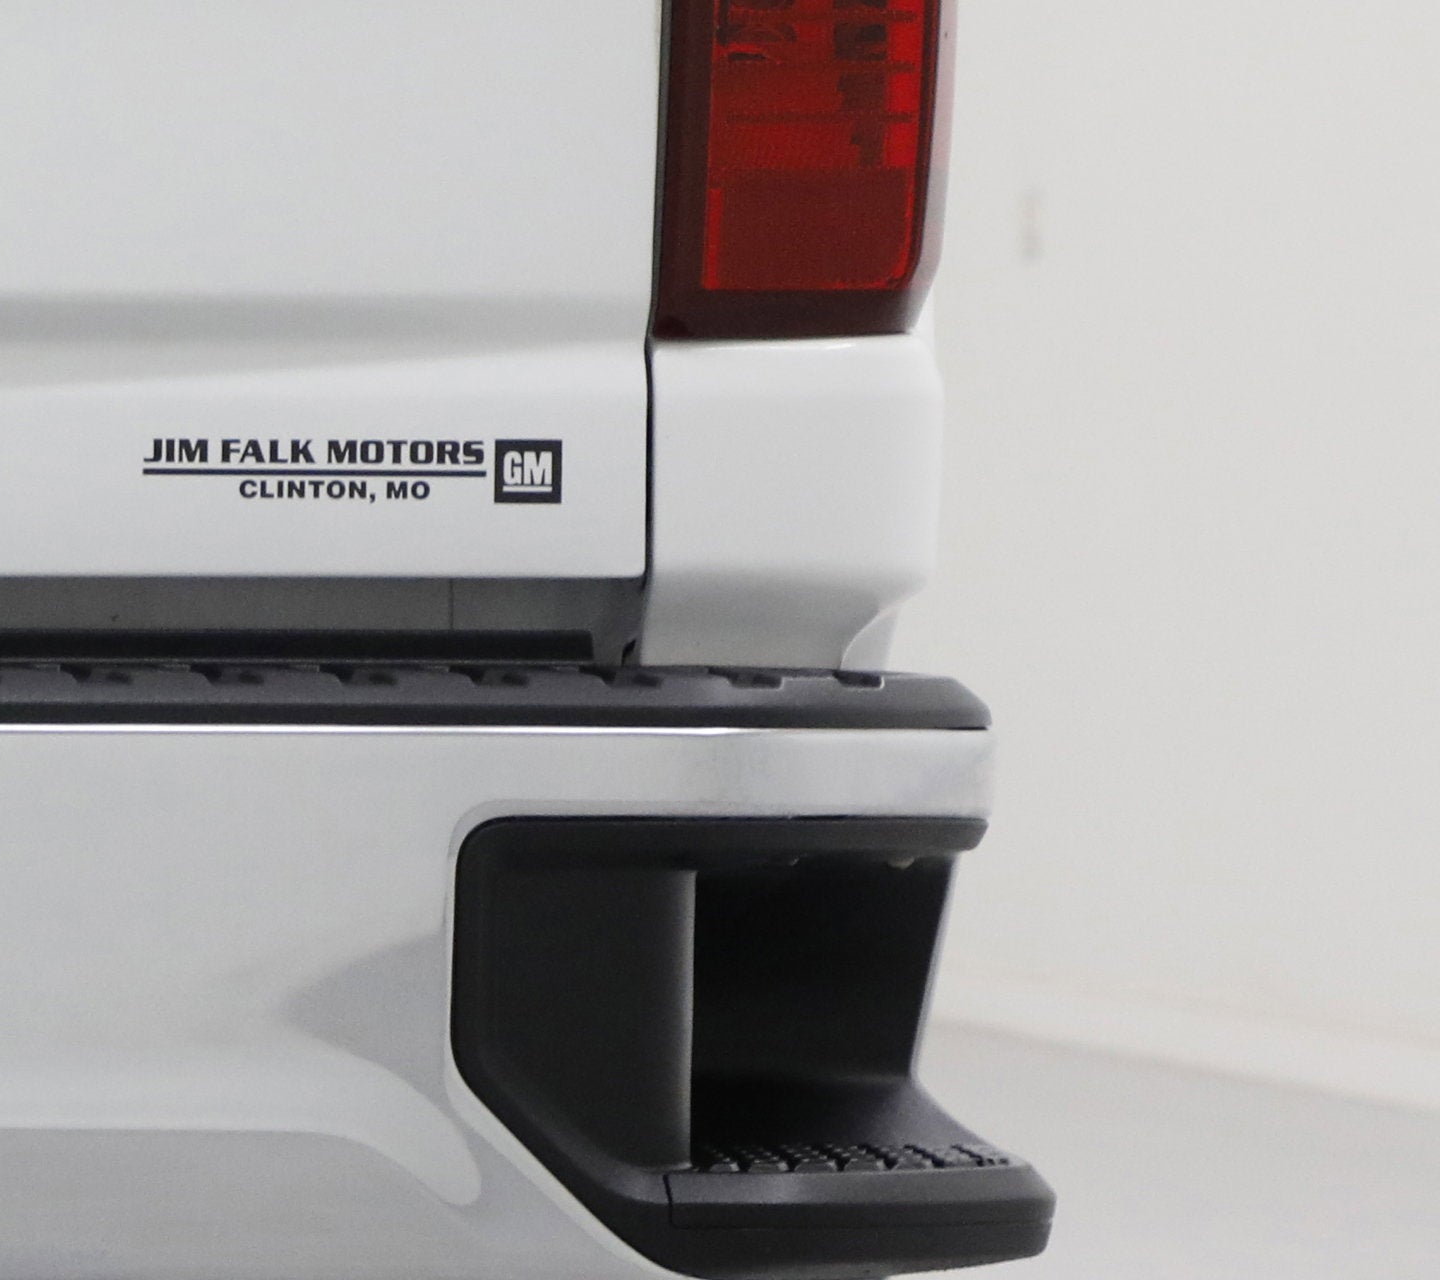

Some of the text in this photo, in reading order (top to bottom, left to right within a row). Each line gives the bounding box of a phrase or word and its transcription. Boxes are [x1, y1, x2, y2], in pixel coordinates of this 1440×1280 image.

[143, 438, 484, 465] JIM FALK MOTORS
[502, 450, 553, 487] GM
[238, 479, 430, 503] CLINTON, MO
